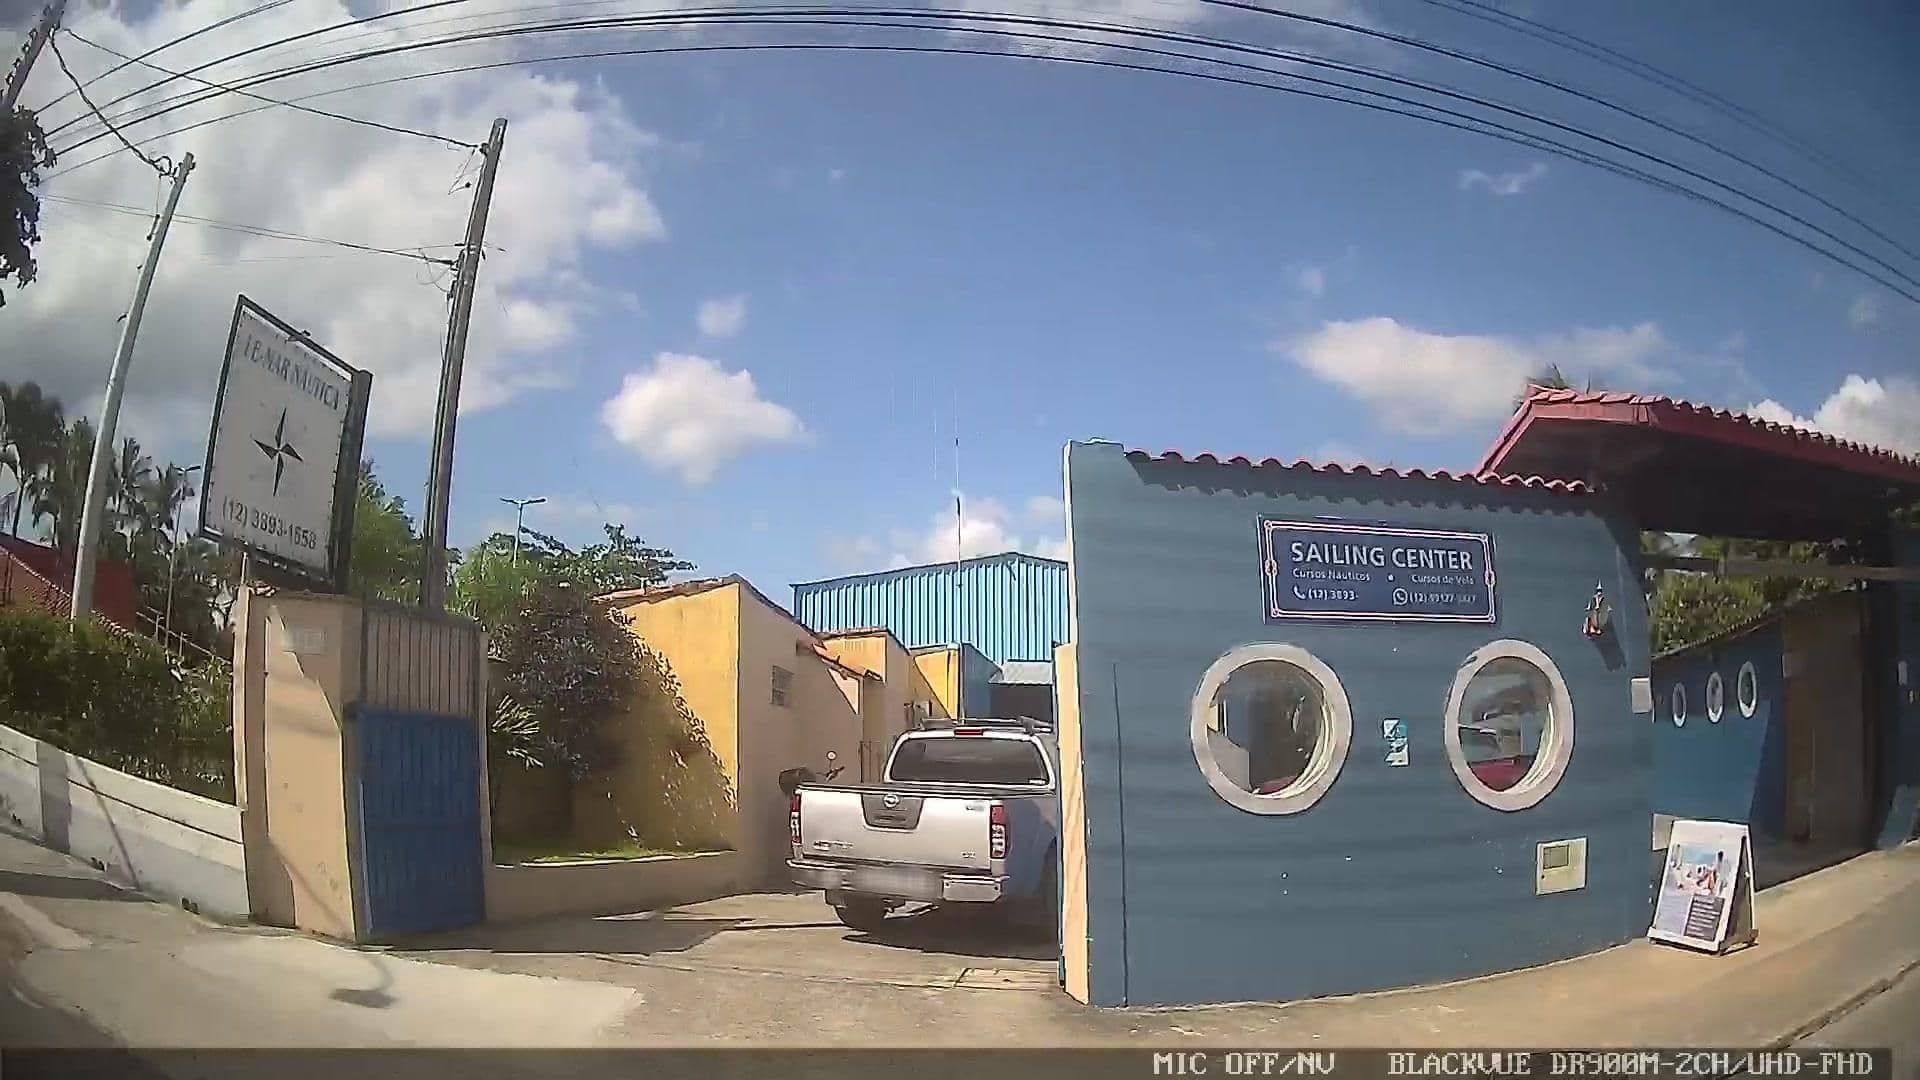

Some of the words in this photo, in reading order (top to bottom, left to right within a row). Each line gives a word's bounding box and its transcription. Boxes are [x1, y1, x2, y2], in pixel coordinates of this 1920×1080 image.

[222, 496, 248, 528] (12)
[251, 508, 317, 550] 3893-1658
[1291, 541, 1386, 567] SAILING
[1391, 547, 1474, 570] CENTER
[1292, 567, 1326, 579] Cursos
[1411, 574, 1441, 584] Cursos
[1442, 575, 1454, 584] de
[1308, 588, 1328, 600] (12)
[1409, 592, 1428, 603] (12)
